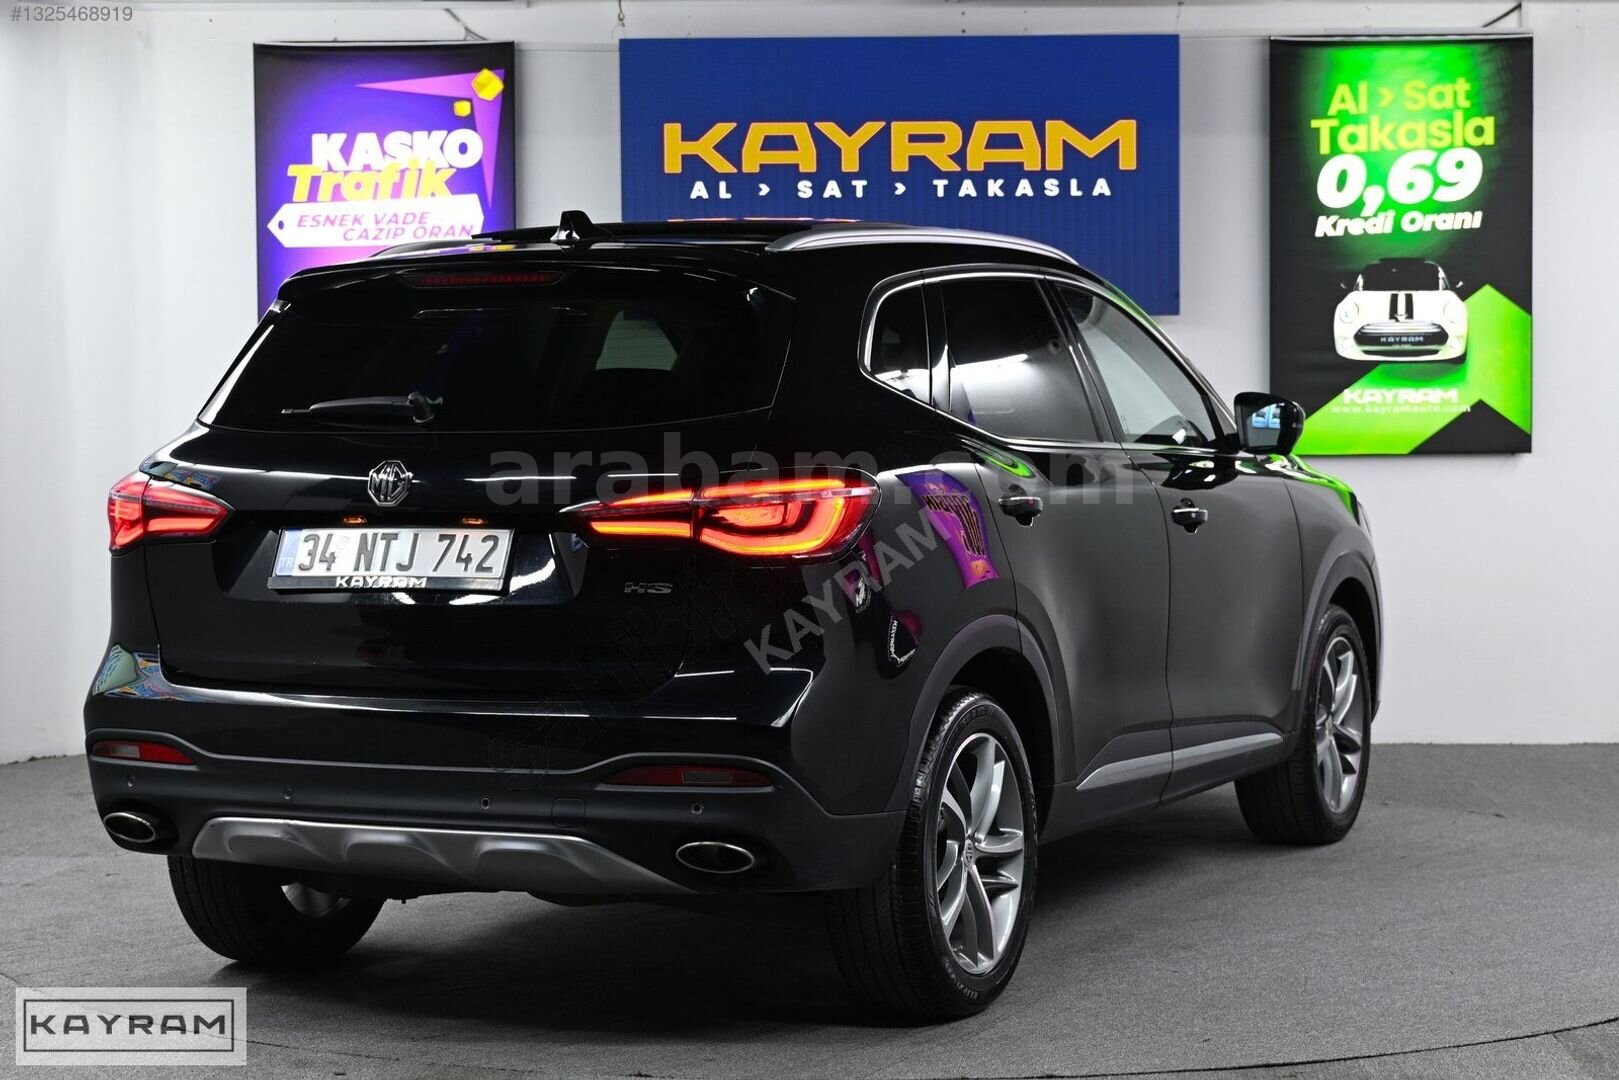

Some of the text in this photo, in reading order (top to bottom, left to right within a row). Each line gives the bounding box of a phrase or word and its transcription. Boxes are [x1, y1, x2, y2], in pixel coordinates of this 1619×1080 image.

[1327, 81, 1368, 116] Al
[1403, 77, 1471, 112] Sat
[312, 128, 483, 171] KASKO
[663, 119, 1137, 174] KAYRAM
[1310, 110, 1496, 155] Takasla
[287, 158, 457, 203] Trafik
[690, 180, 732, 200] AL
[797, 179, 868, 199] SAT
[933, 178, 1112, 198] TAKASLA
[1316, 147, 1484, 217] 0,69
[296, 211, 431, 229] ESNEK VADE
[343, 223, 474, 243] CAZIP ORAN
[1315, 210, 1394, 237] Kredi
[1343, 387, 1459, 405] KAYRAM
[299, 532, 499, 574] 34 NTJ 742
[335, 575, 427, 588] KAYRAM
